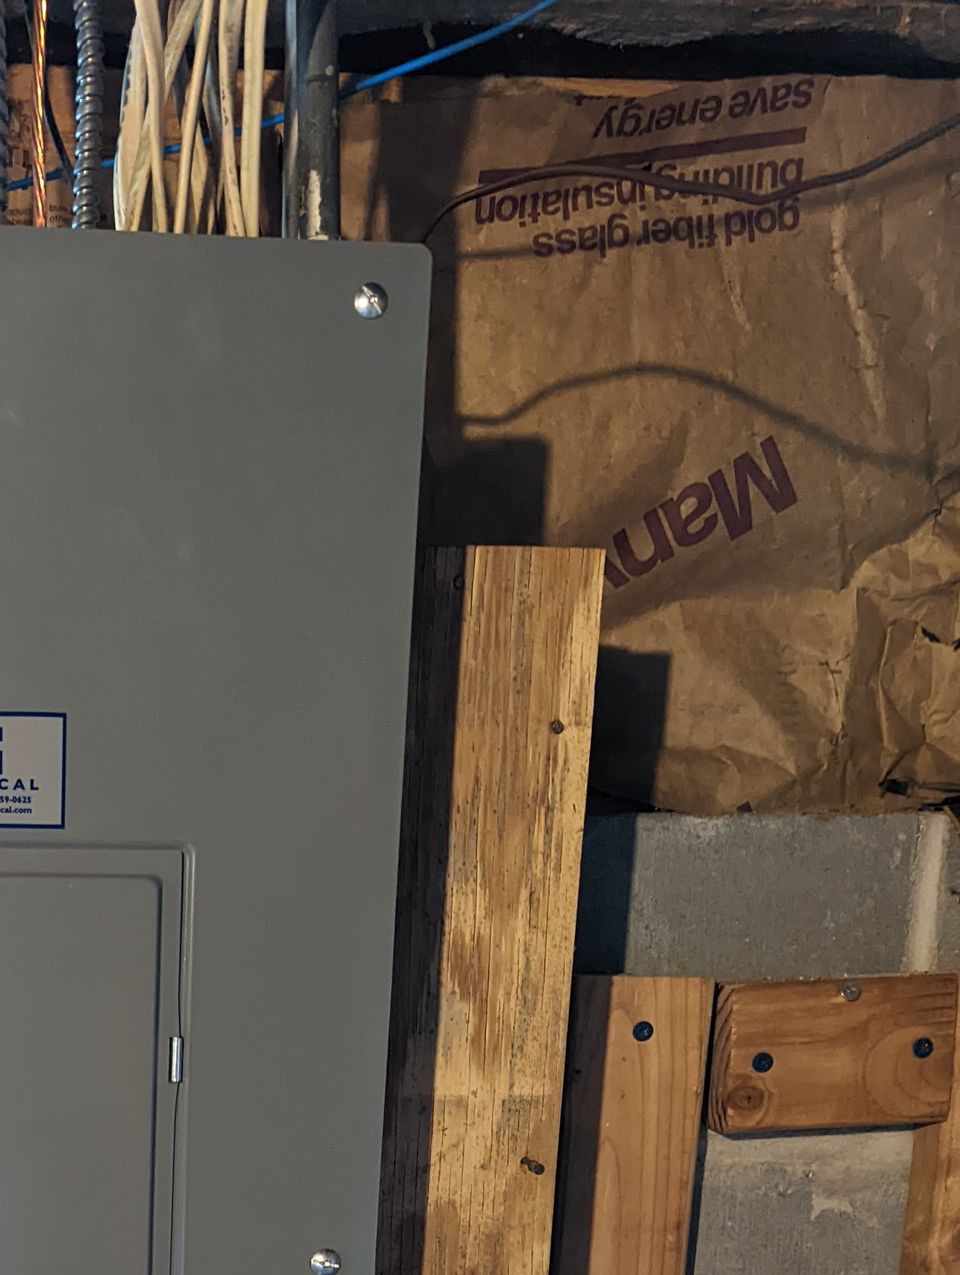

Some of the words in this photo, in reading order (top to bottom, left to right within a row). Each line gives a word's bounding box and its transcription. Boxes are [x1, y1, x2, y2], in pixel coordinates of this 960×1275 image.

[592, 95, 722, 140] energy
[729, 79, 815, 119] save
[474, 176, 646, 228] insulation
[724, 197, 800, 248] gold
[532, 211, 631, 259] glass
[636, 211, 718, 249] fiber
